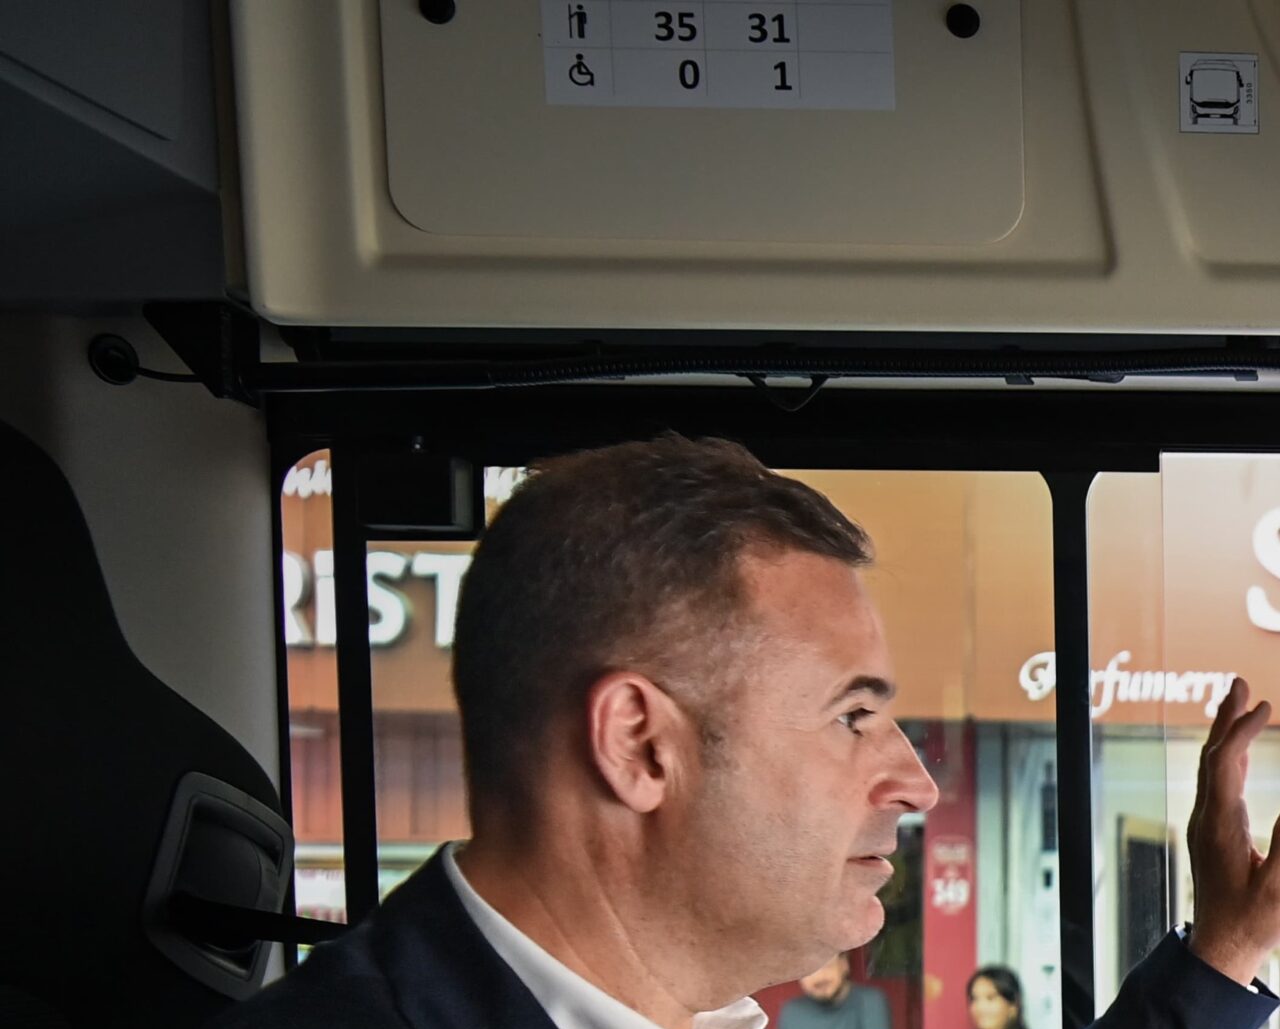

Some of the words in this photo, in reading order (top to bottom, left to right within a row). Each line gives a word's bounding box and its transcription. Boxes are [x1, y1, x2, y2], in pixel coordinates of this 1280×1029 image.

[654, 11, 697, 42] 35
[748, 13, 791, 43] 31
[678, 59, 700, 90] 0
[773, 61, 792, 91] 1
[1019, 650, 1239, 719] Prfumery
